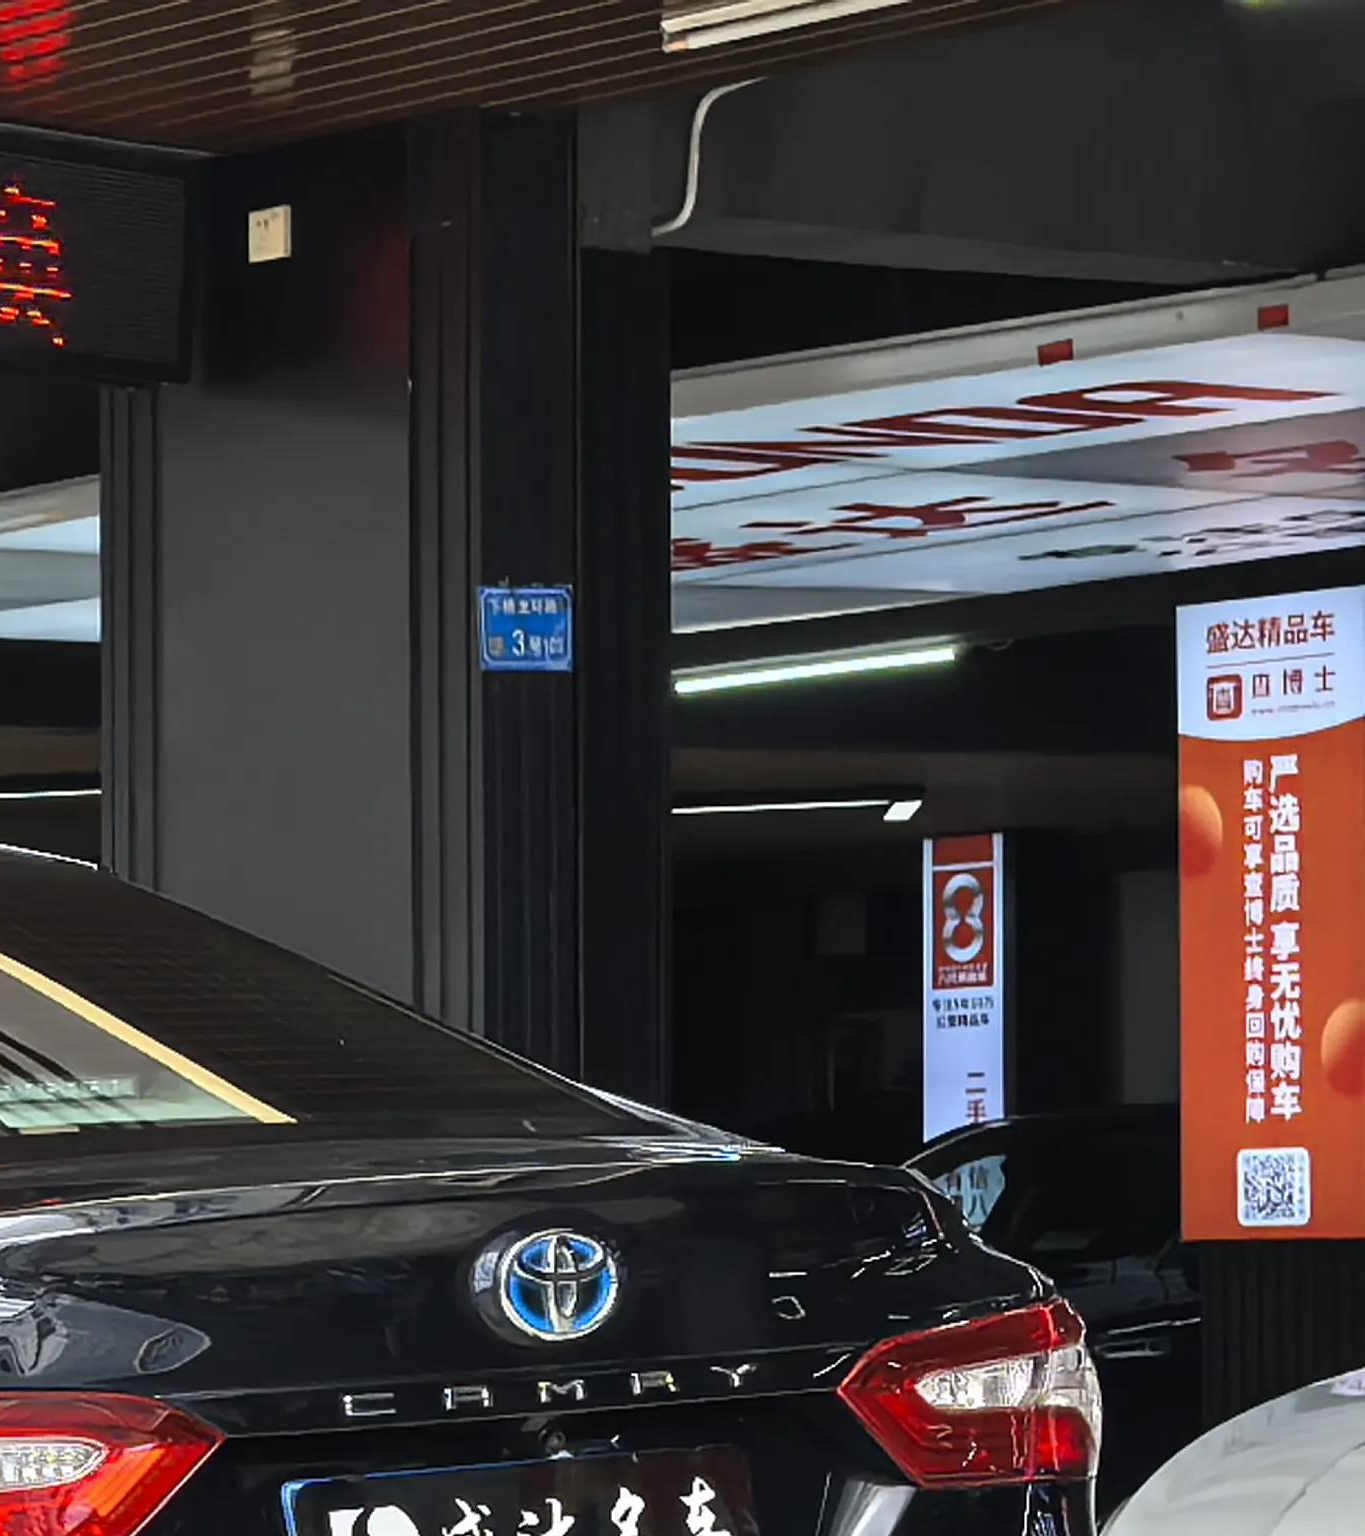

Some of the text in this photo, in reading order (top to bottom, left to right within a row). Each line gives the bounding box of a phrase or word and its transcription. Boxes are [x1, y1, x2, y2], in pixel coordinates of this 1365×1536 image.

[1206, 610, 1335, 653] 盛达精品车
[1269, 754, 1302, 1121] 严选品质 享无忧购车
[342, 1362, 759, 1418] CAMRY
